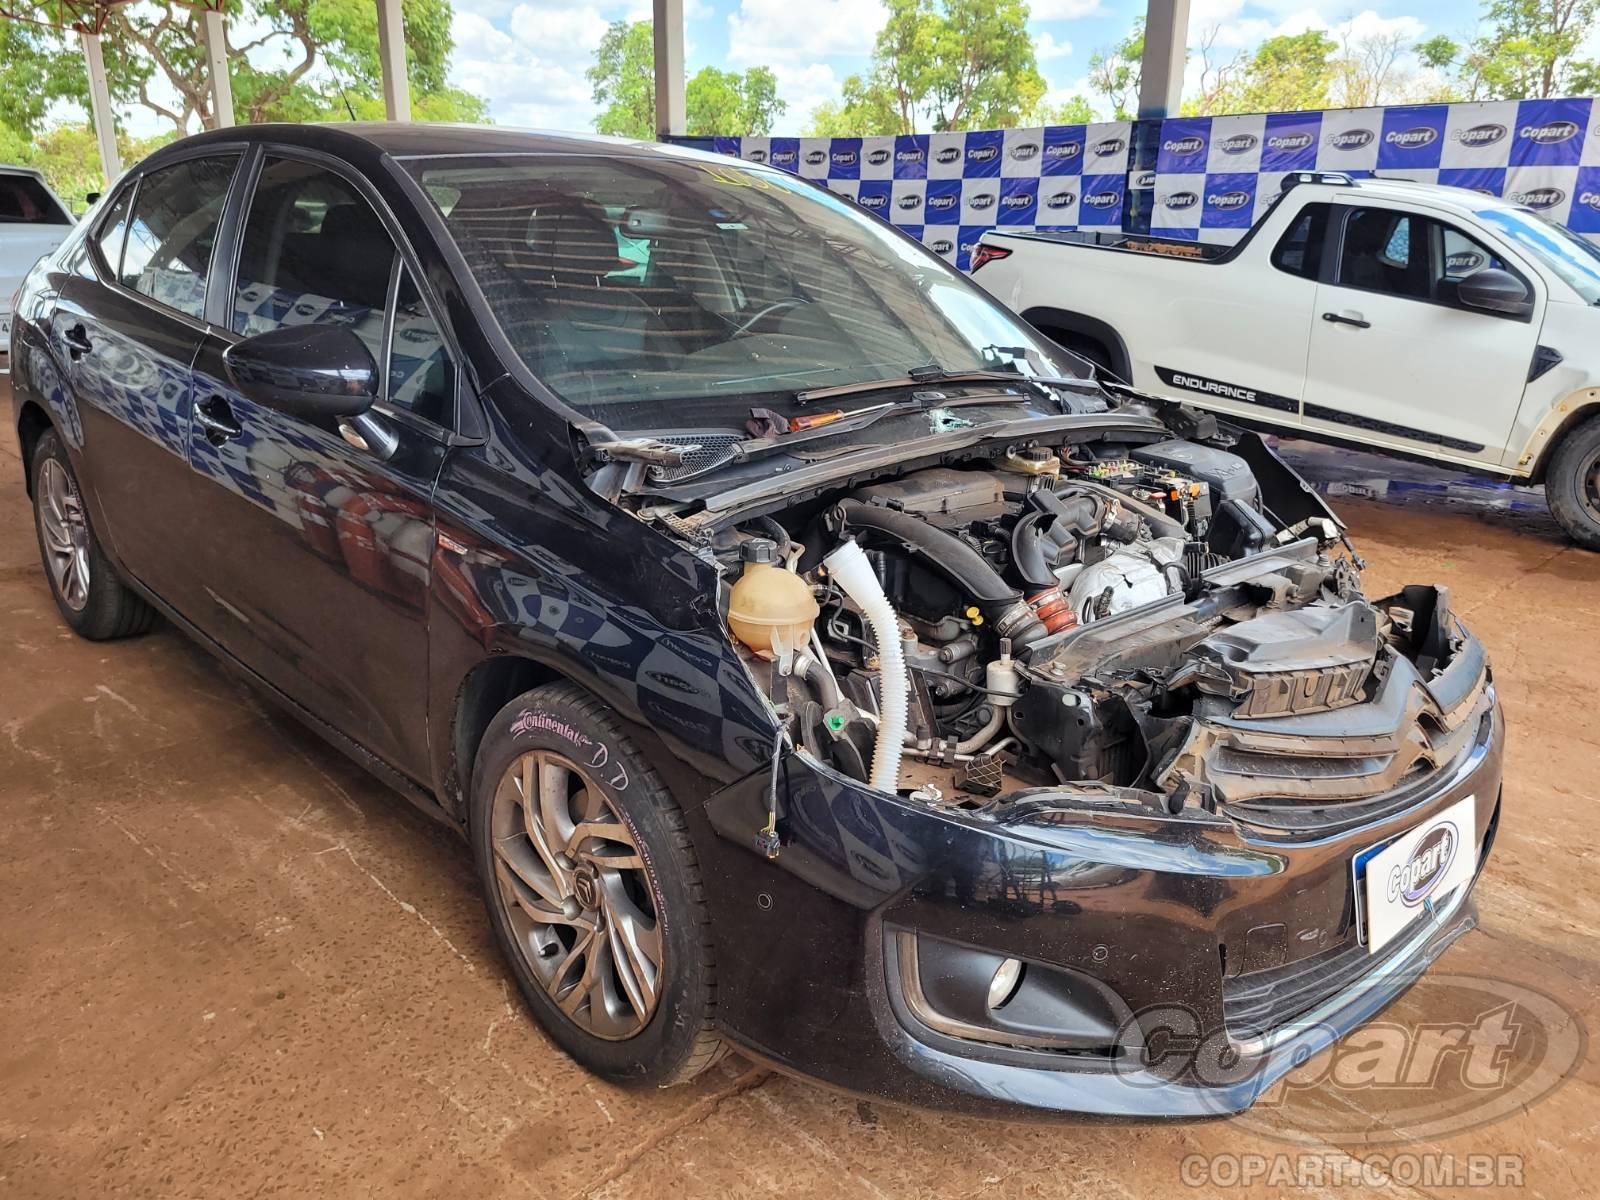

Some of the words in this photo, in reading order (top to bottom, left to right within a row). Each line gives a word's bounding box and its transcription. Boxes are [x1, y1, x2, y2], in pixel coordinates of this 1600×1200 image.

[1385, 129, 1431, 145] Copart
[1451, 126, 1500, 142] Copart
[1520, 122, 1573, 140] Copart
[1163, 139, 1199, 153] Copart
[1268, 133, 1308, 149] Copart
[1326, 131, 1368, 148] Copart
[772, 152, 794, 162] Copart
[832, 152, 854, 163] Copart
[897, 151, 922, 163] Copart
[967, 148, 995, 161] Copart
[1046, 144, 1077, 157] Copart
[928, 196, 954, 208] Copart
[1002, 195, 1030, 208] Copart
[1083, 193, 1116, 206] Copart
[1207, 193, 1245, 208] Copart
[1508, 189, 1557, 206] Copart
[1446, 255, 1477, 268] part
[1172, 374, 1257, 402] ENDURANCE
[517, 709, 581, 745] Continental
[1386, 827, 1451, 904] Copart
